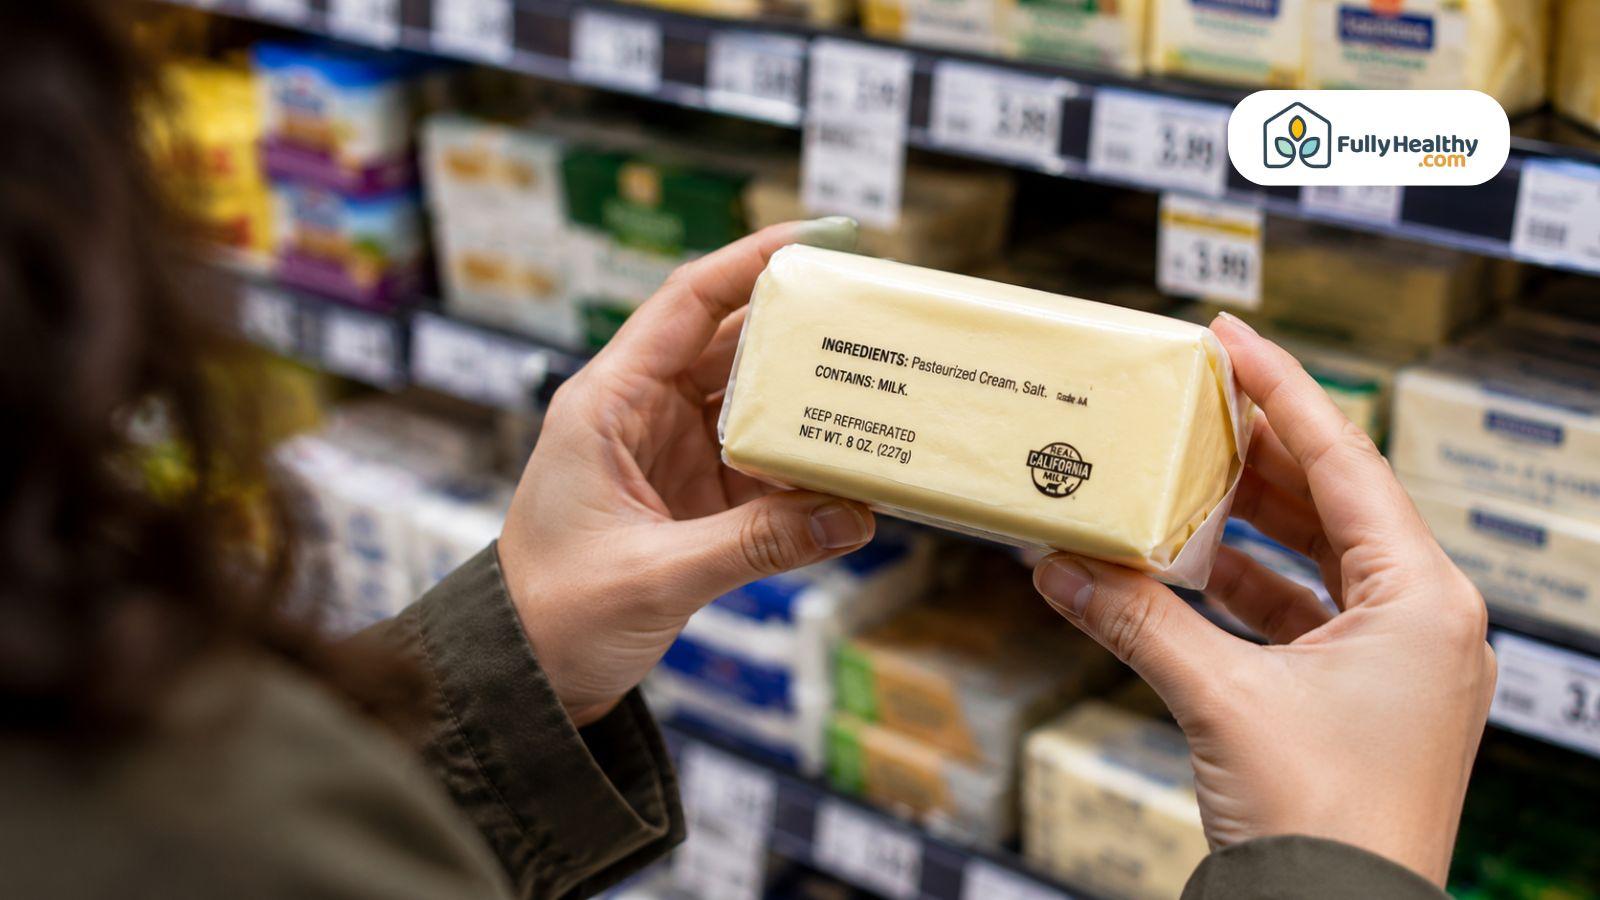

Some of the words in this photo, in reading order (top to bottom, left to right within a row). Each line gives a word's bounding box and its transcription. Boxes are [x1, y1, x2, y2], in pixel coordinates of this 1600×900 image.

[815, 365, 876, 389] CONTAINS:
[877, 378, 908, 396] MILK.
[821, 336, 909, 367] INGREDIENTS:
[911, 356, 977, 382] Pasteurized
[979, 371, 1019, 393] Cream,
[1022, 380, 1047, 398] Salt.
[803, 406, 832, 423] KEEP
[833, 413, 916, 443] REFRIGERATED
[799, 424, 822, 440] NET
[824, 430, 843, 446] WT.
[846, 435, 854, 448] 8
[856, 438, 874, 454] OZ.
[876, 443, 912, 464] (227g)
[1050, 445, 1074, 459] REAL
[1029, 452, 1090, 479] CALIFORNIA
[1042, 470, 1069, 484] MILK
